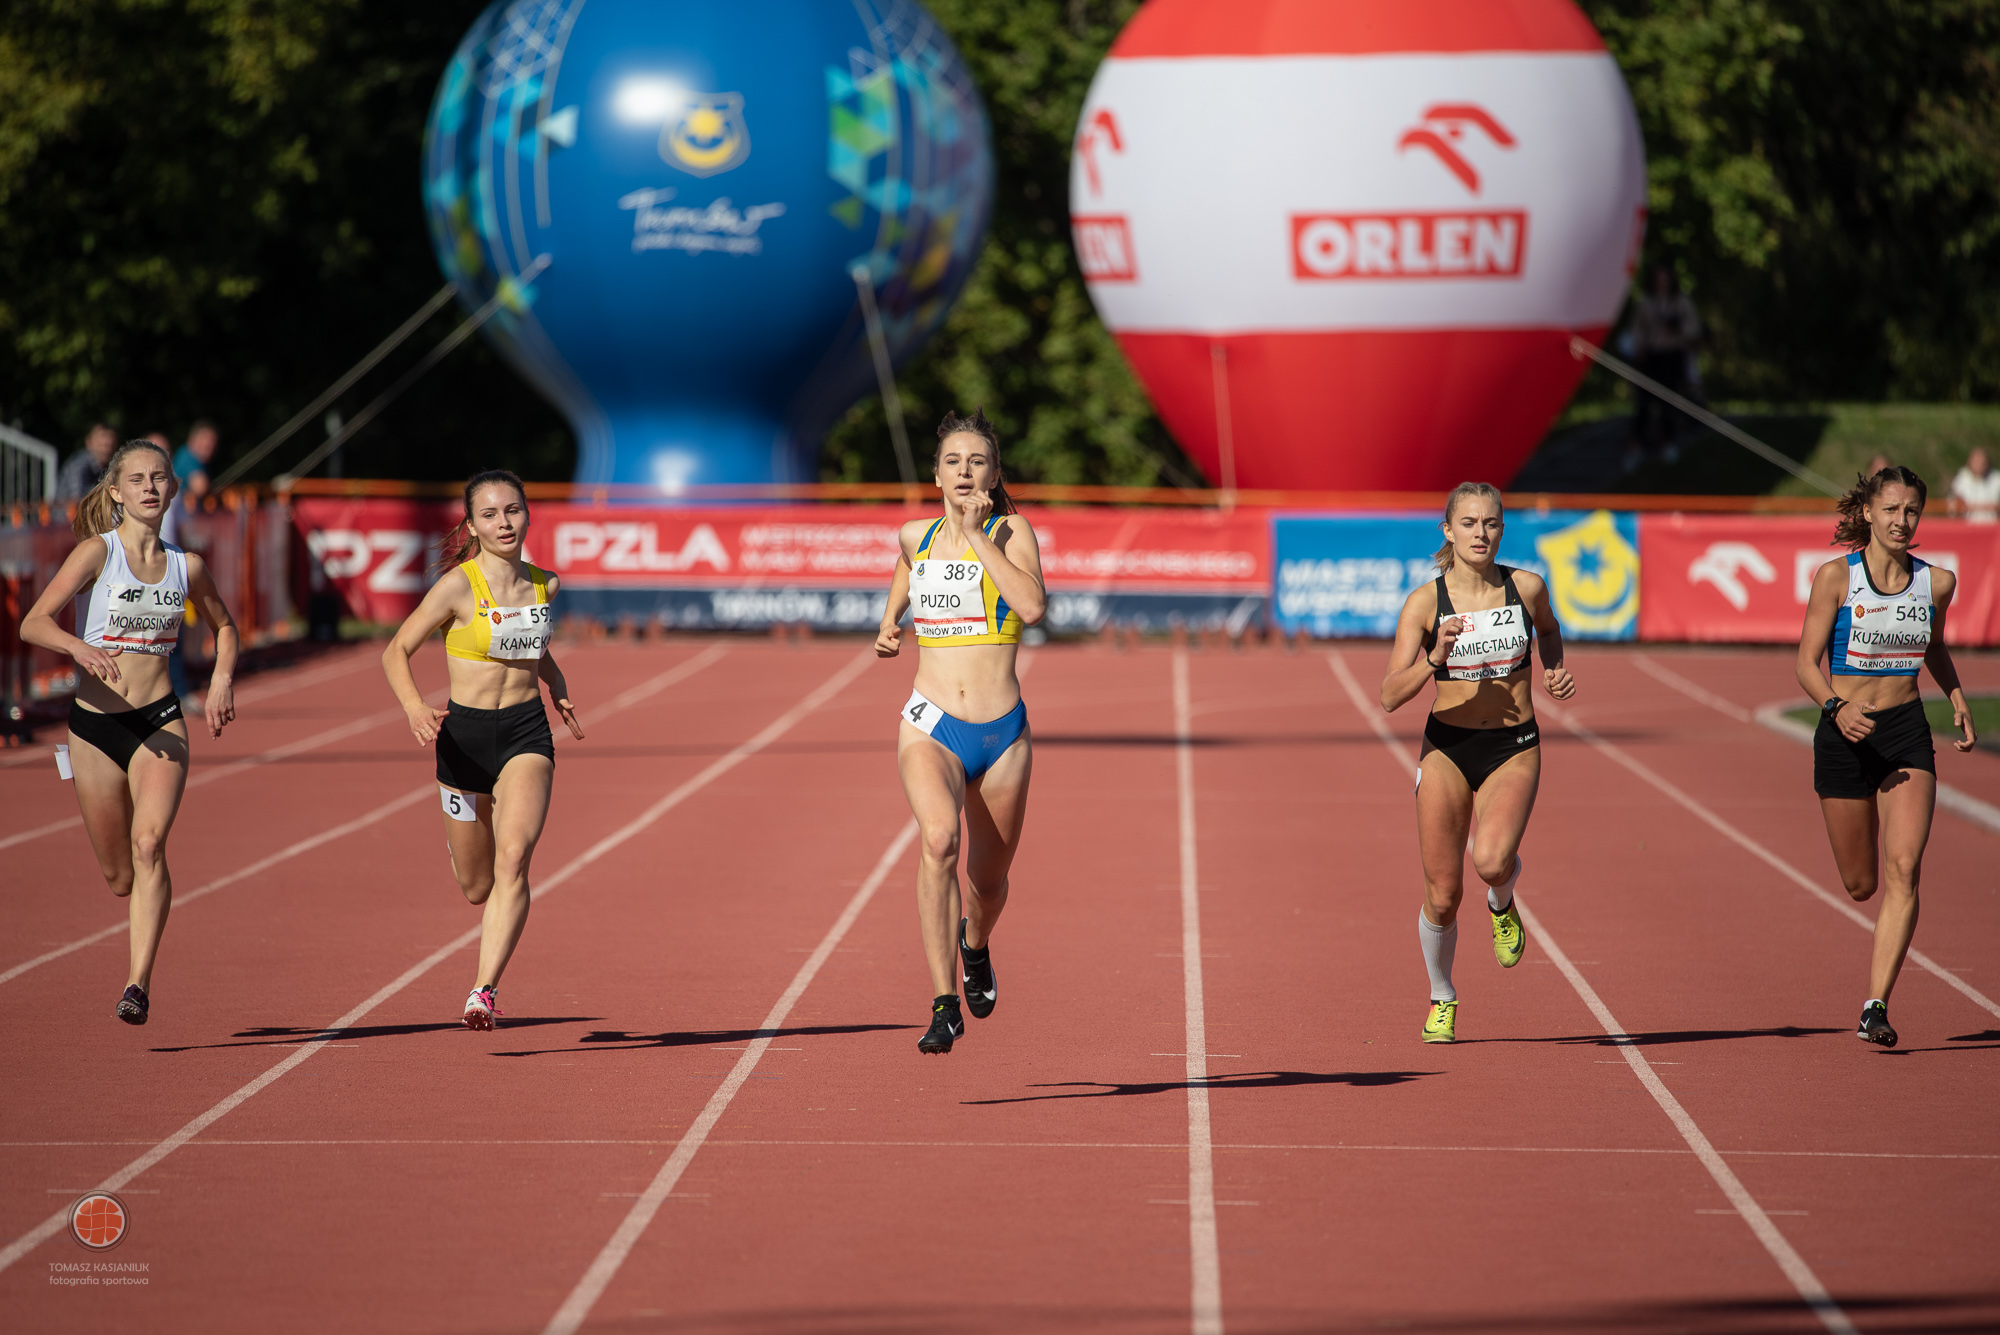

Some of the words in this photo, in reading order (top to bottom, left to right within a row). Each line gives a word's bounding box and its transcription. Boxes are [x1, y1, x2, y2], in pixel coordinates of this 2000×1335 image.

[1299, 216, 1518, 277] ORLEN
[555, 521, 731, 572] PZLA
[944, 564, 979, 581] 389
[153, 589, 181, 607] 168
[921, 594, 961, 608] PUZIO
[1491, 609, 1515, 626] 22
[1895, 606, 1927, 622] 543
[921, 626, 950, 636] TARNÓW
[952, 625, 973, 635] 2019
[1852, 630, 1928, 646] KUŹMIŃSKA
[1858, 659, 1894, 669] TARNÓW
[1895, 660, 1913, 668] 2019
[909, 702, 928, 722] 4
[449, 794, 461, 815] 5
